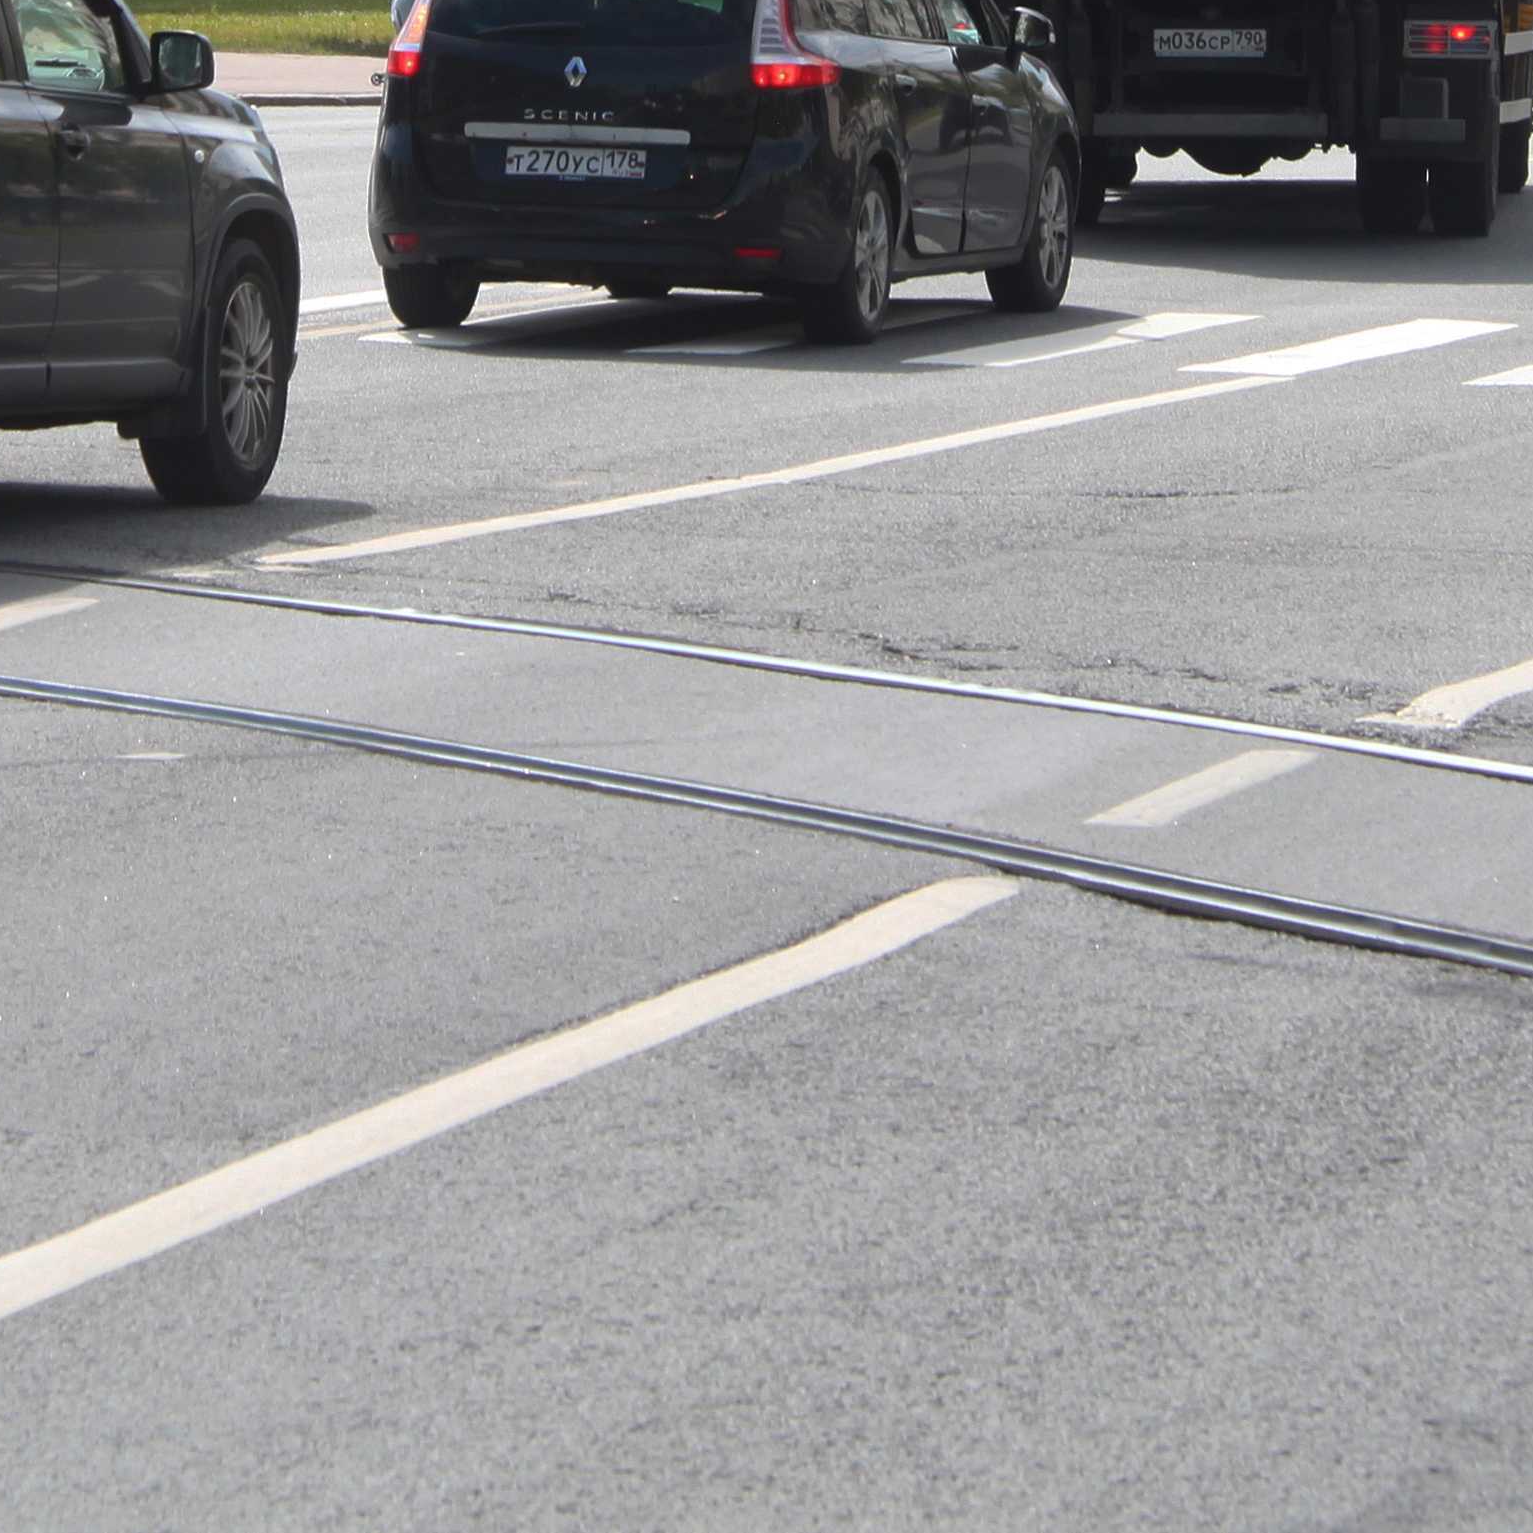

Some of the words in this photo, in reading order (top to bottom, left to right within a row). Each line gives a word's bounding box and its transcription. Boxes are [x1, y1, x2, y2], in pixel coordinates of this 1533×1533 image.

[1235, 31, 1263, 46] 790
[523, 108, 614, 122] SCENIC
[605, 151, 639, 170] 178
